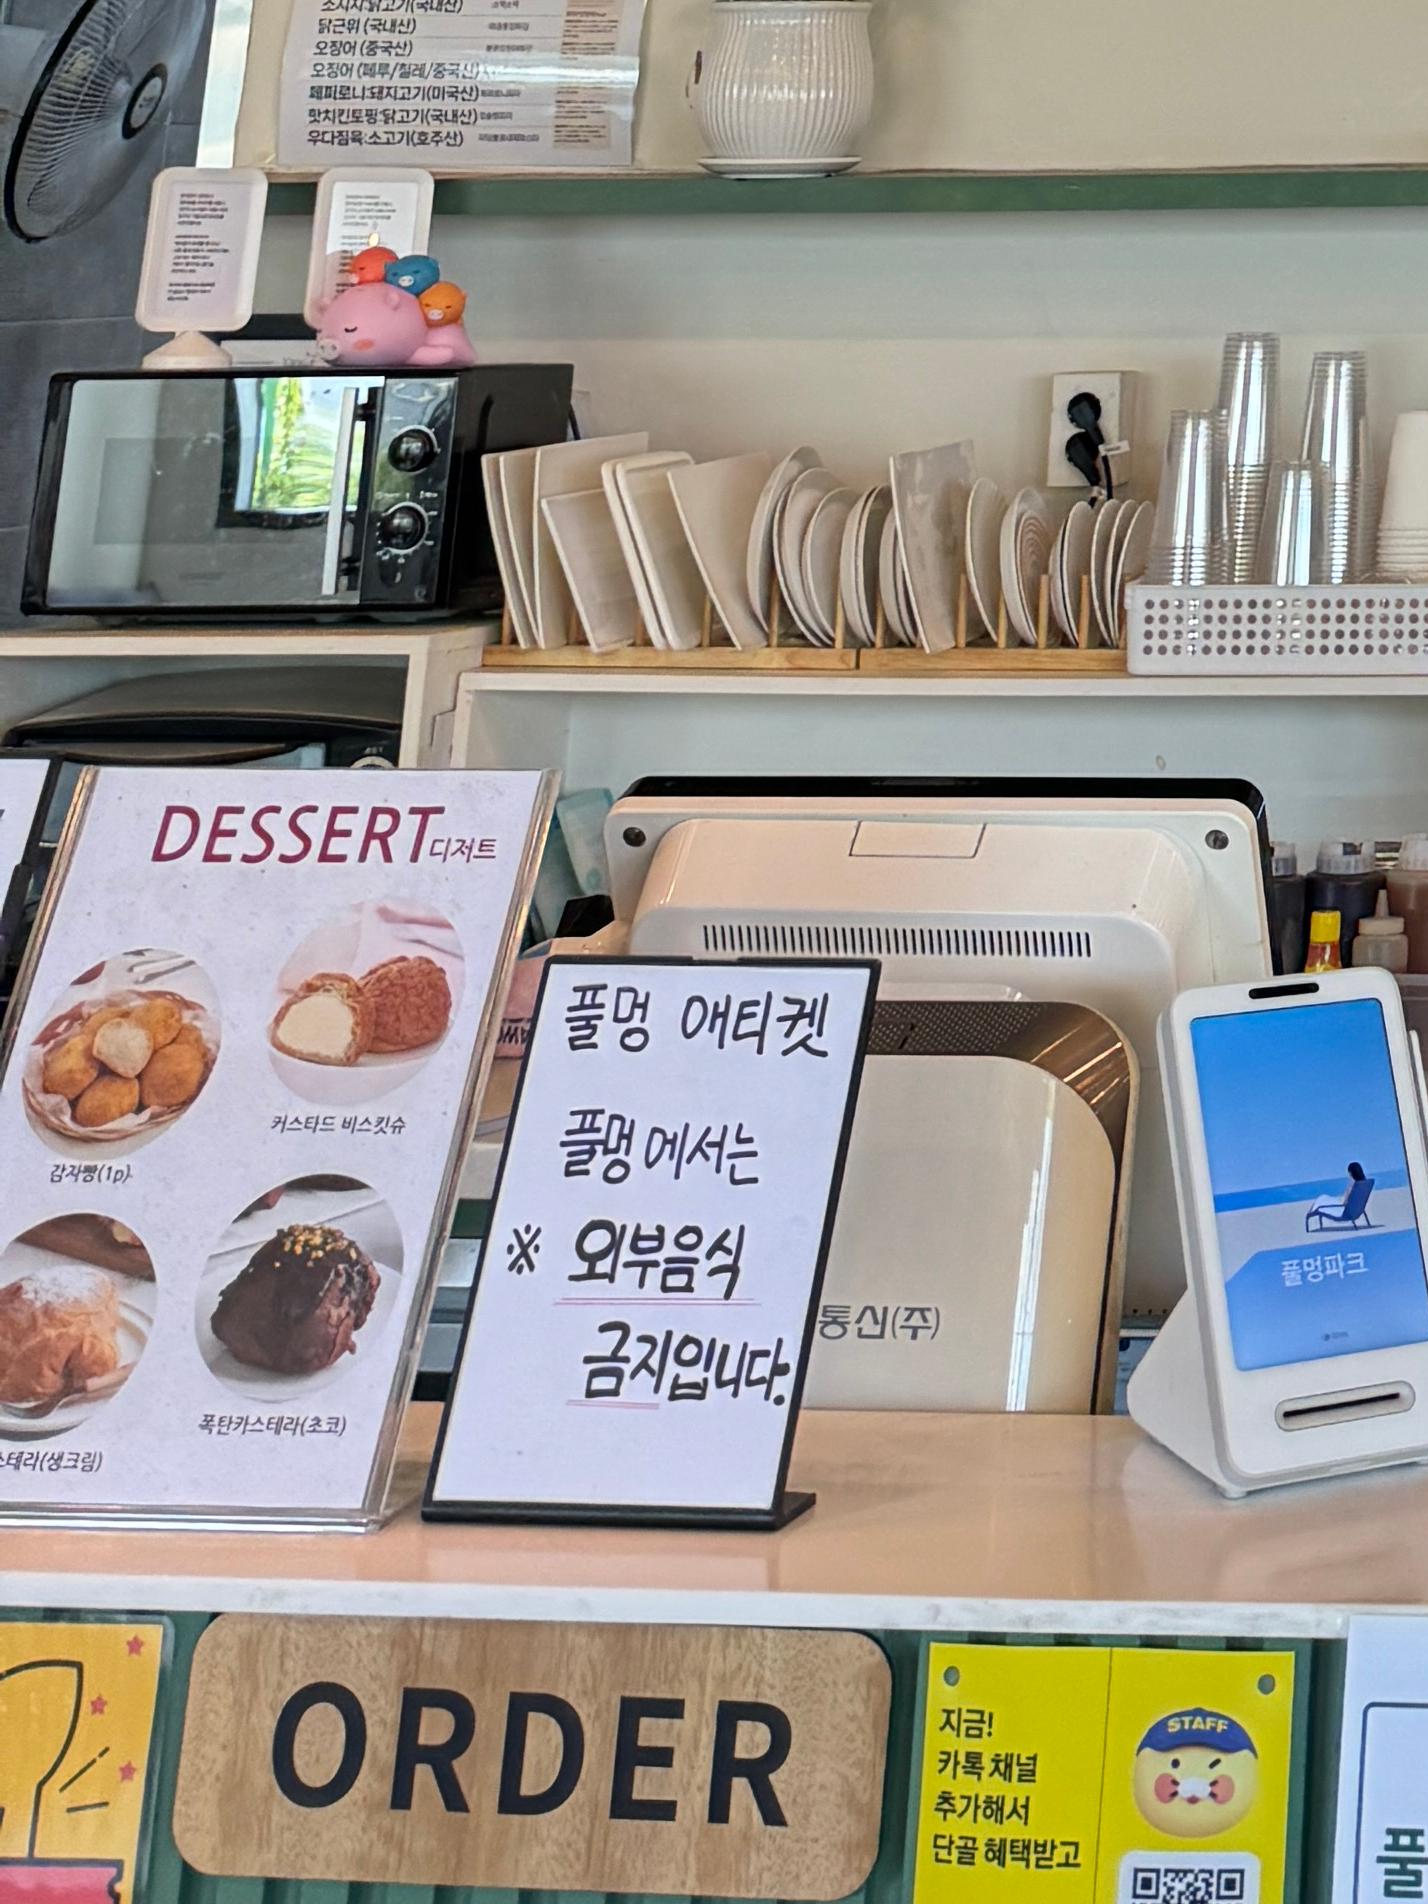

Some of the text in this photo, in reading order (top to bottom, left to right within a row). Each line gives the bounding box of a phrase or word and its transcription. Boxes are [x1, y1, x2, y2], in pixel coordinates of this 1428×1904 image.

[313, 41, 356, 56] 오징어
[151, 805, 497, 864] DESSERT 디저트
[565, 983, 830, 1058] 풀멍 애티켓
[271, 1113, 407, 1134] 커스타드 비스킷슈
[49, 1162, 134, 1185] 감자빵(1p)
[567, 1218, 746, 1301] 외부음식
[1280, 1252, 1369, 1287] 풀멍파크
[582, 1320, 790, 1406] 금지입니다.
[199, 1415, 347, 1436] 폭탄카스테라(초코)
[937, 1707, 994, 1739] 지금!
[1167, 1716, 1229, 1734] STAFF
[270, 1680, 794, 1829] ORDER
[937, 1749, 1038, 1784] 카톡 채널
[933, 1792, 1029, 1825] 추가해서
[932, 1833, 1081, 1870] 단골 혜택받고
